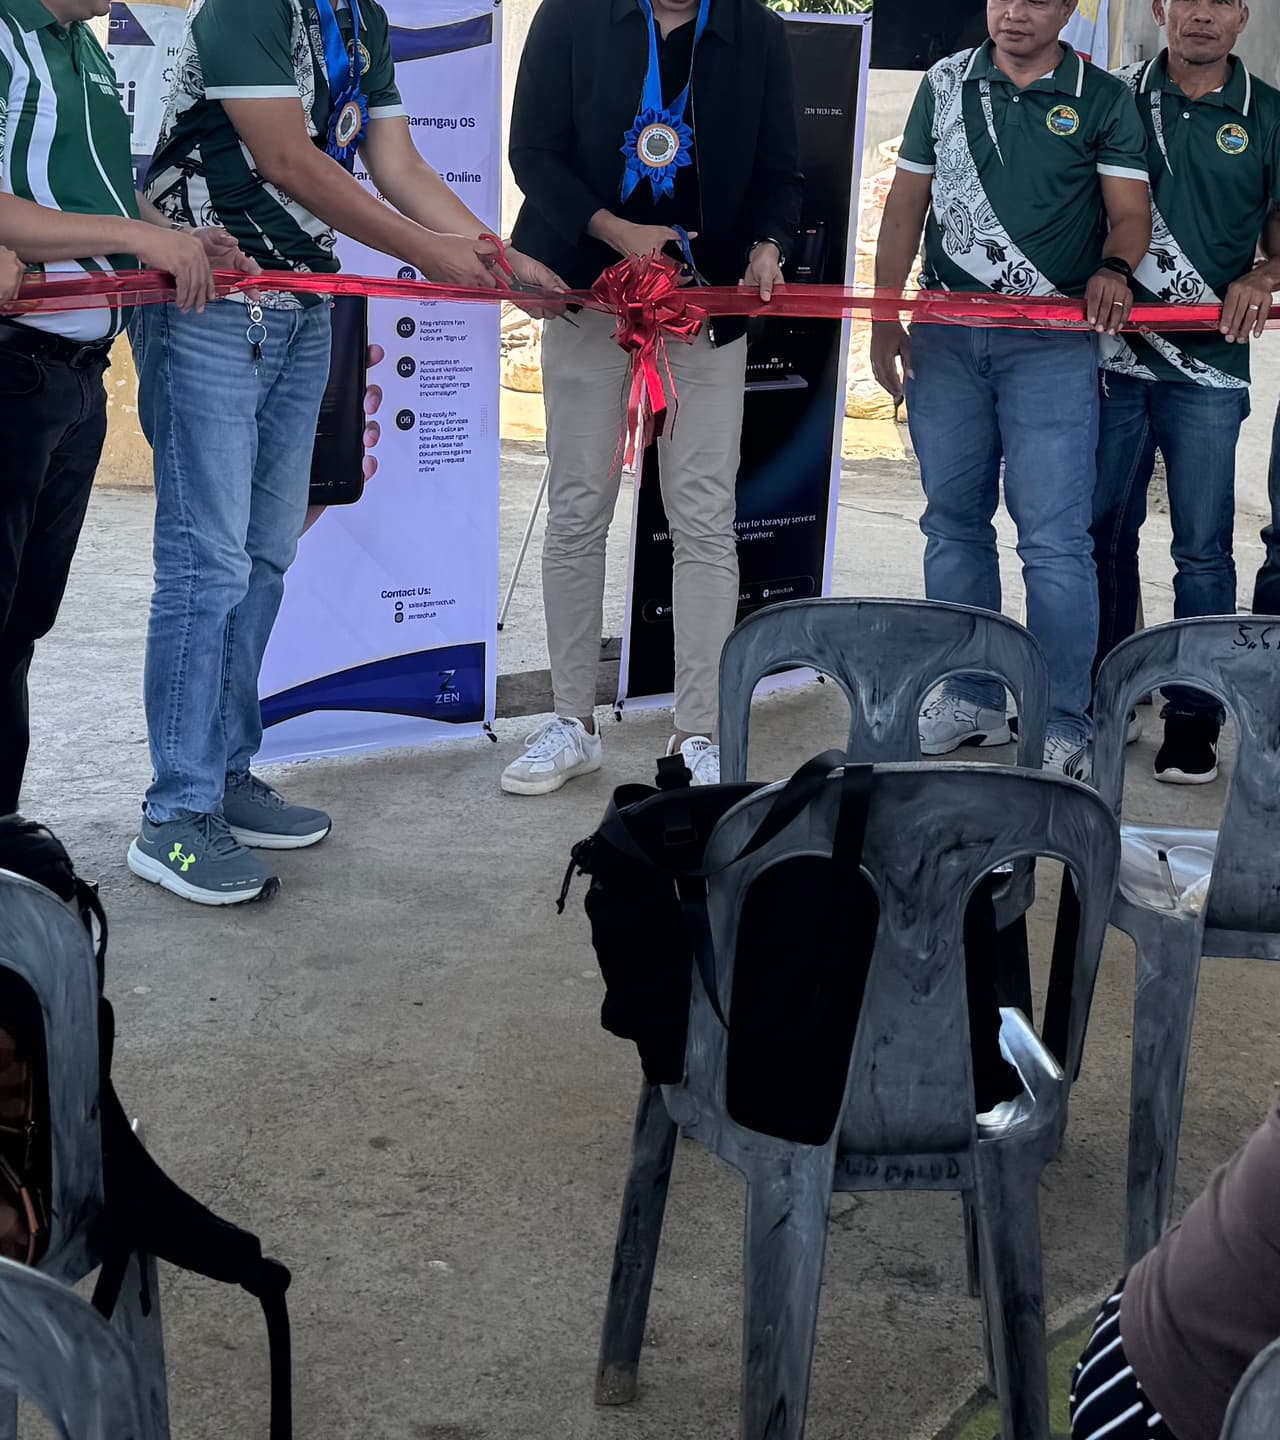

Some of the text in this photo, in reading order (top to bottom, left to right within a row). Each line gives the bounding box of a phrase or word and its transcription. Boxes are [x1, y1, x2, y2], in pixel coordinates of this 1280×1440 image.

[460, 117, 476, 128] OS
[446, 171, 481, 183] Online
[401, 271, 412, 279] 02
[400, 324, 411, 332] 03
[400, 363, 411, 371] 04
[400, 415, 411, 424] 05
[762, 517, 791, 527] barangay
[792, 515, 816, 524] services
[381, 587, 432, 599] Contact Us:
[435, 692, 460, 704] ZEN
